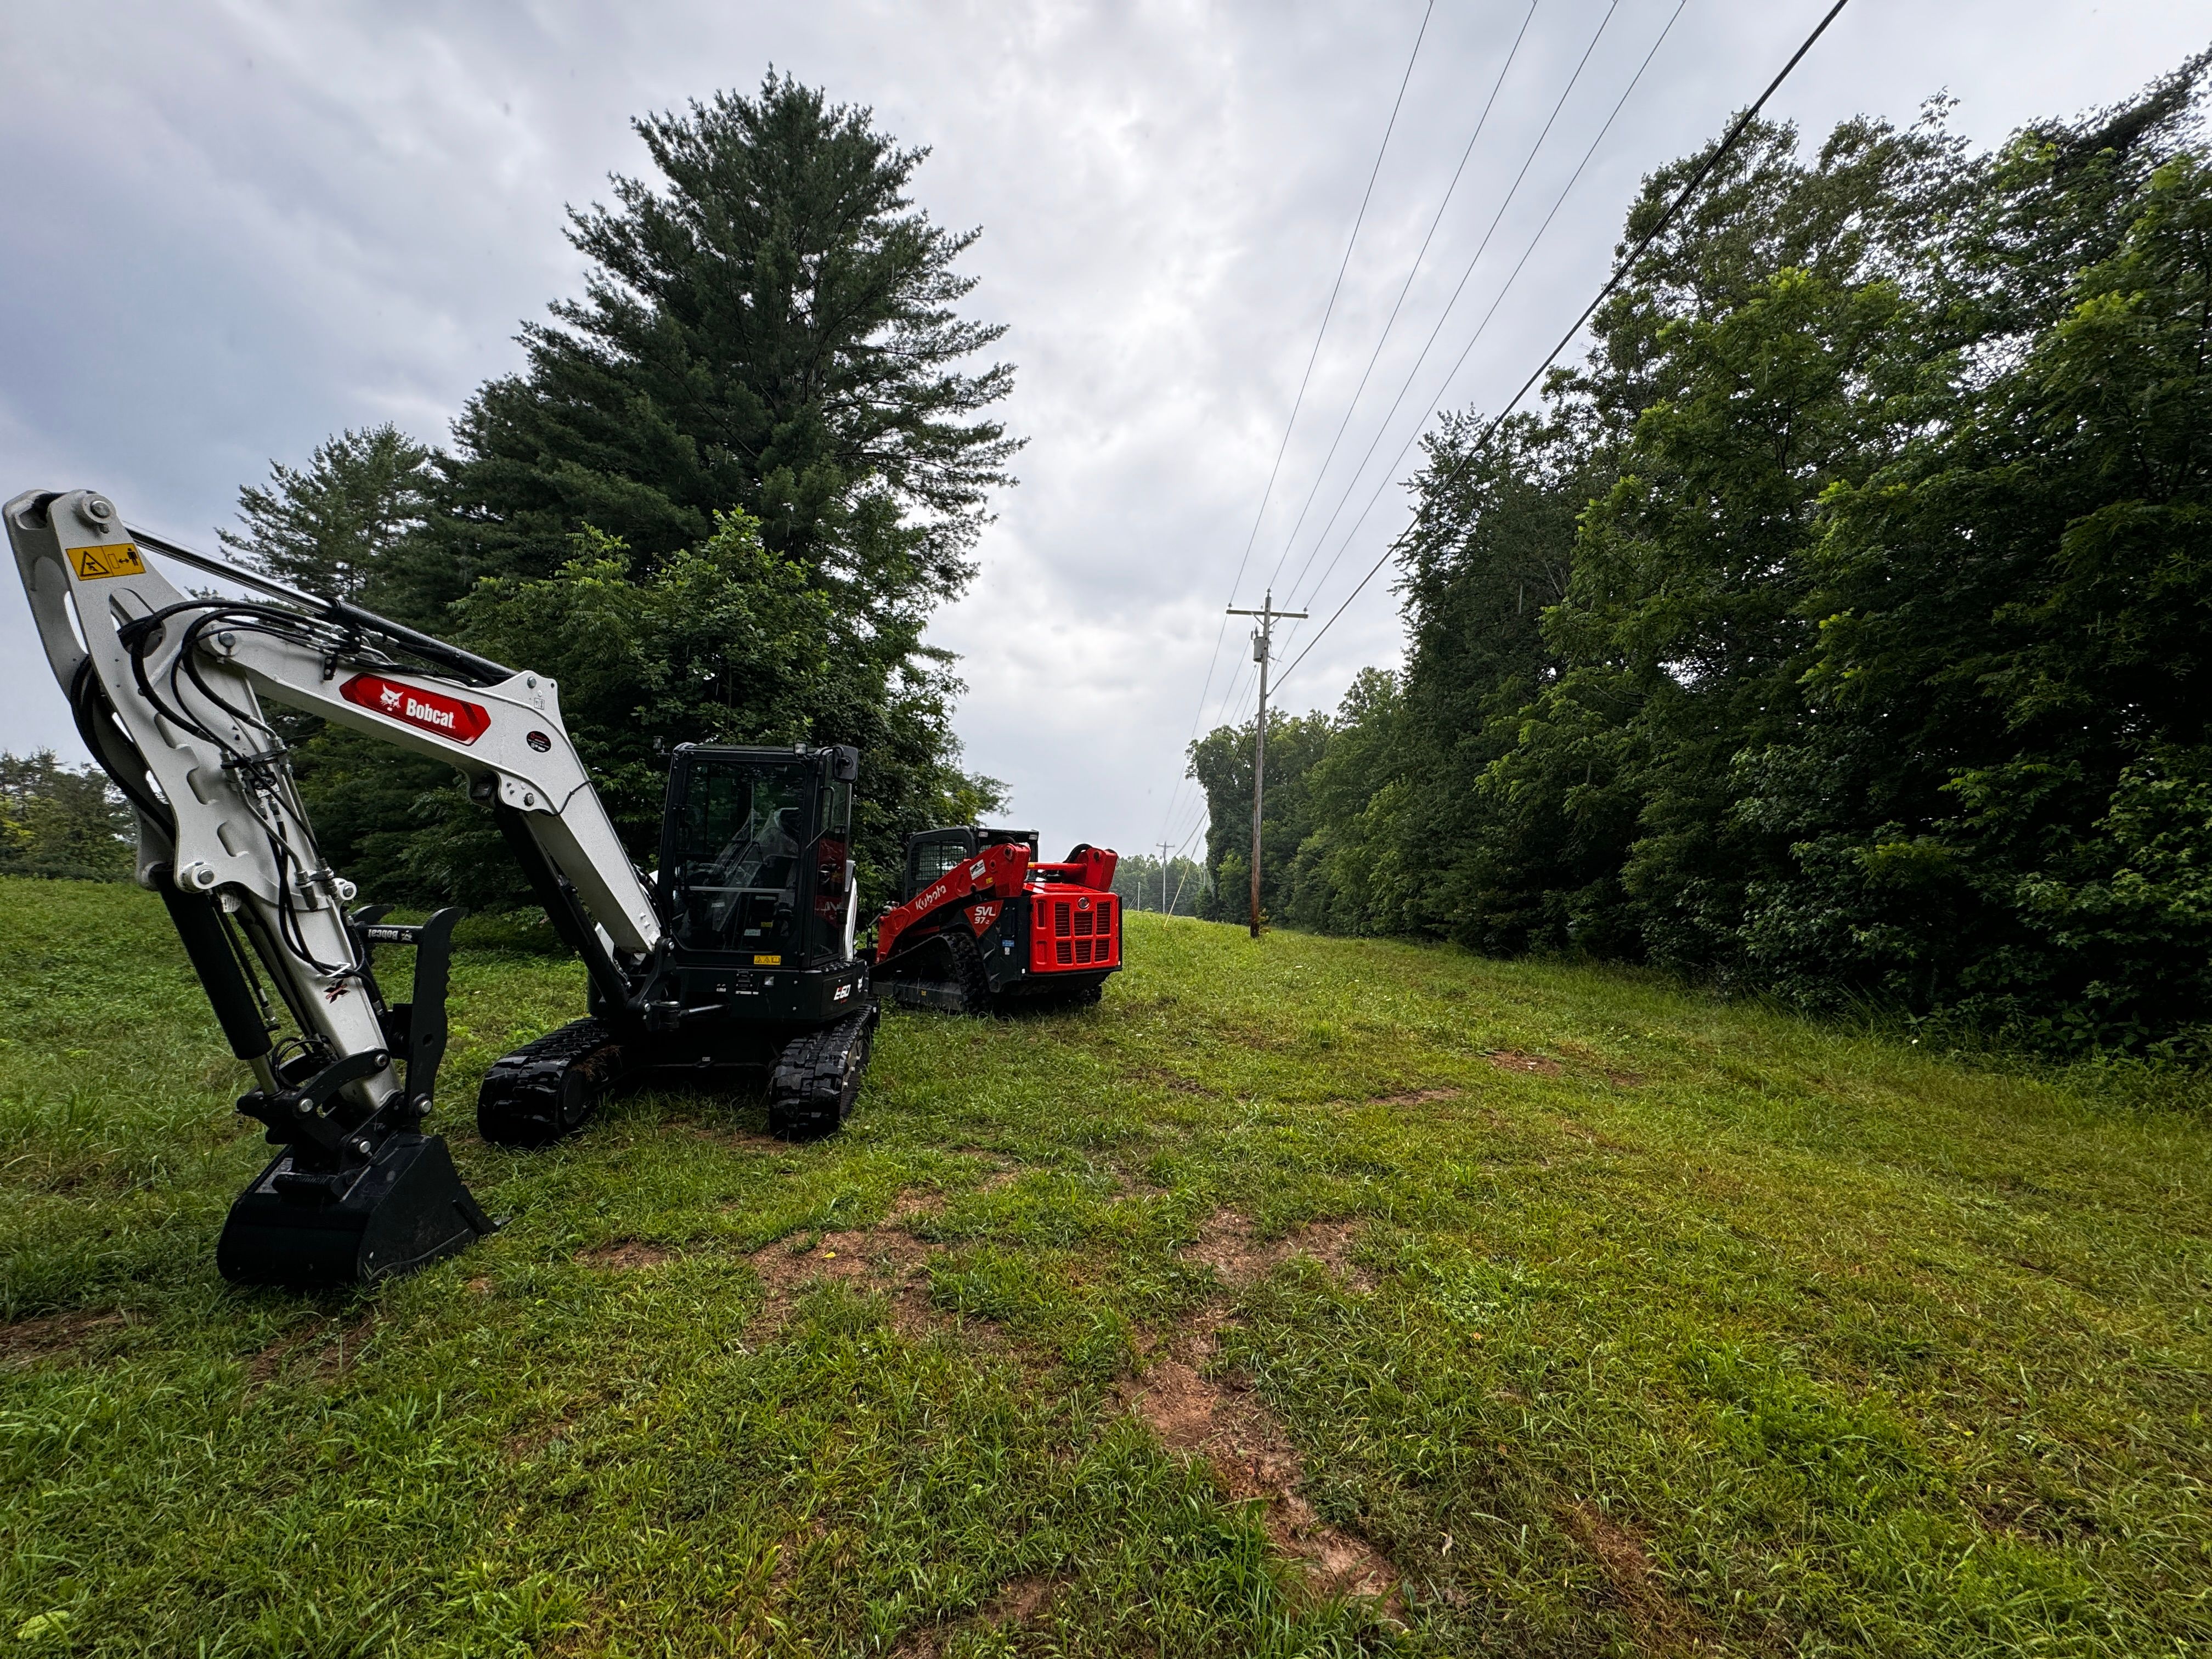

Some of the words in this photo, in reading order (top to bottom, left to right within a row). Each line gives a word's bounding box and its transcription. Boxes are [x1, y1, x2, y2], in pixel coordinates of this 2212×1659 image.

[407, 698, 454, 729] Bobcat
[915, 885, 946, 910] Kubota
[974, 906, 996, 916] SVL
[368, 929, 399, 940] Bobcat
[833, 984, 851, 1001] E60
